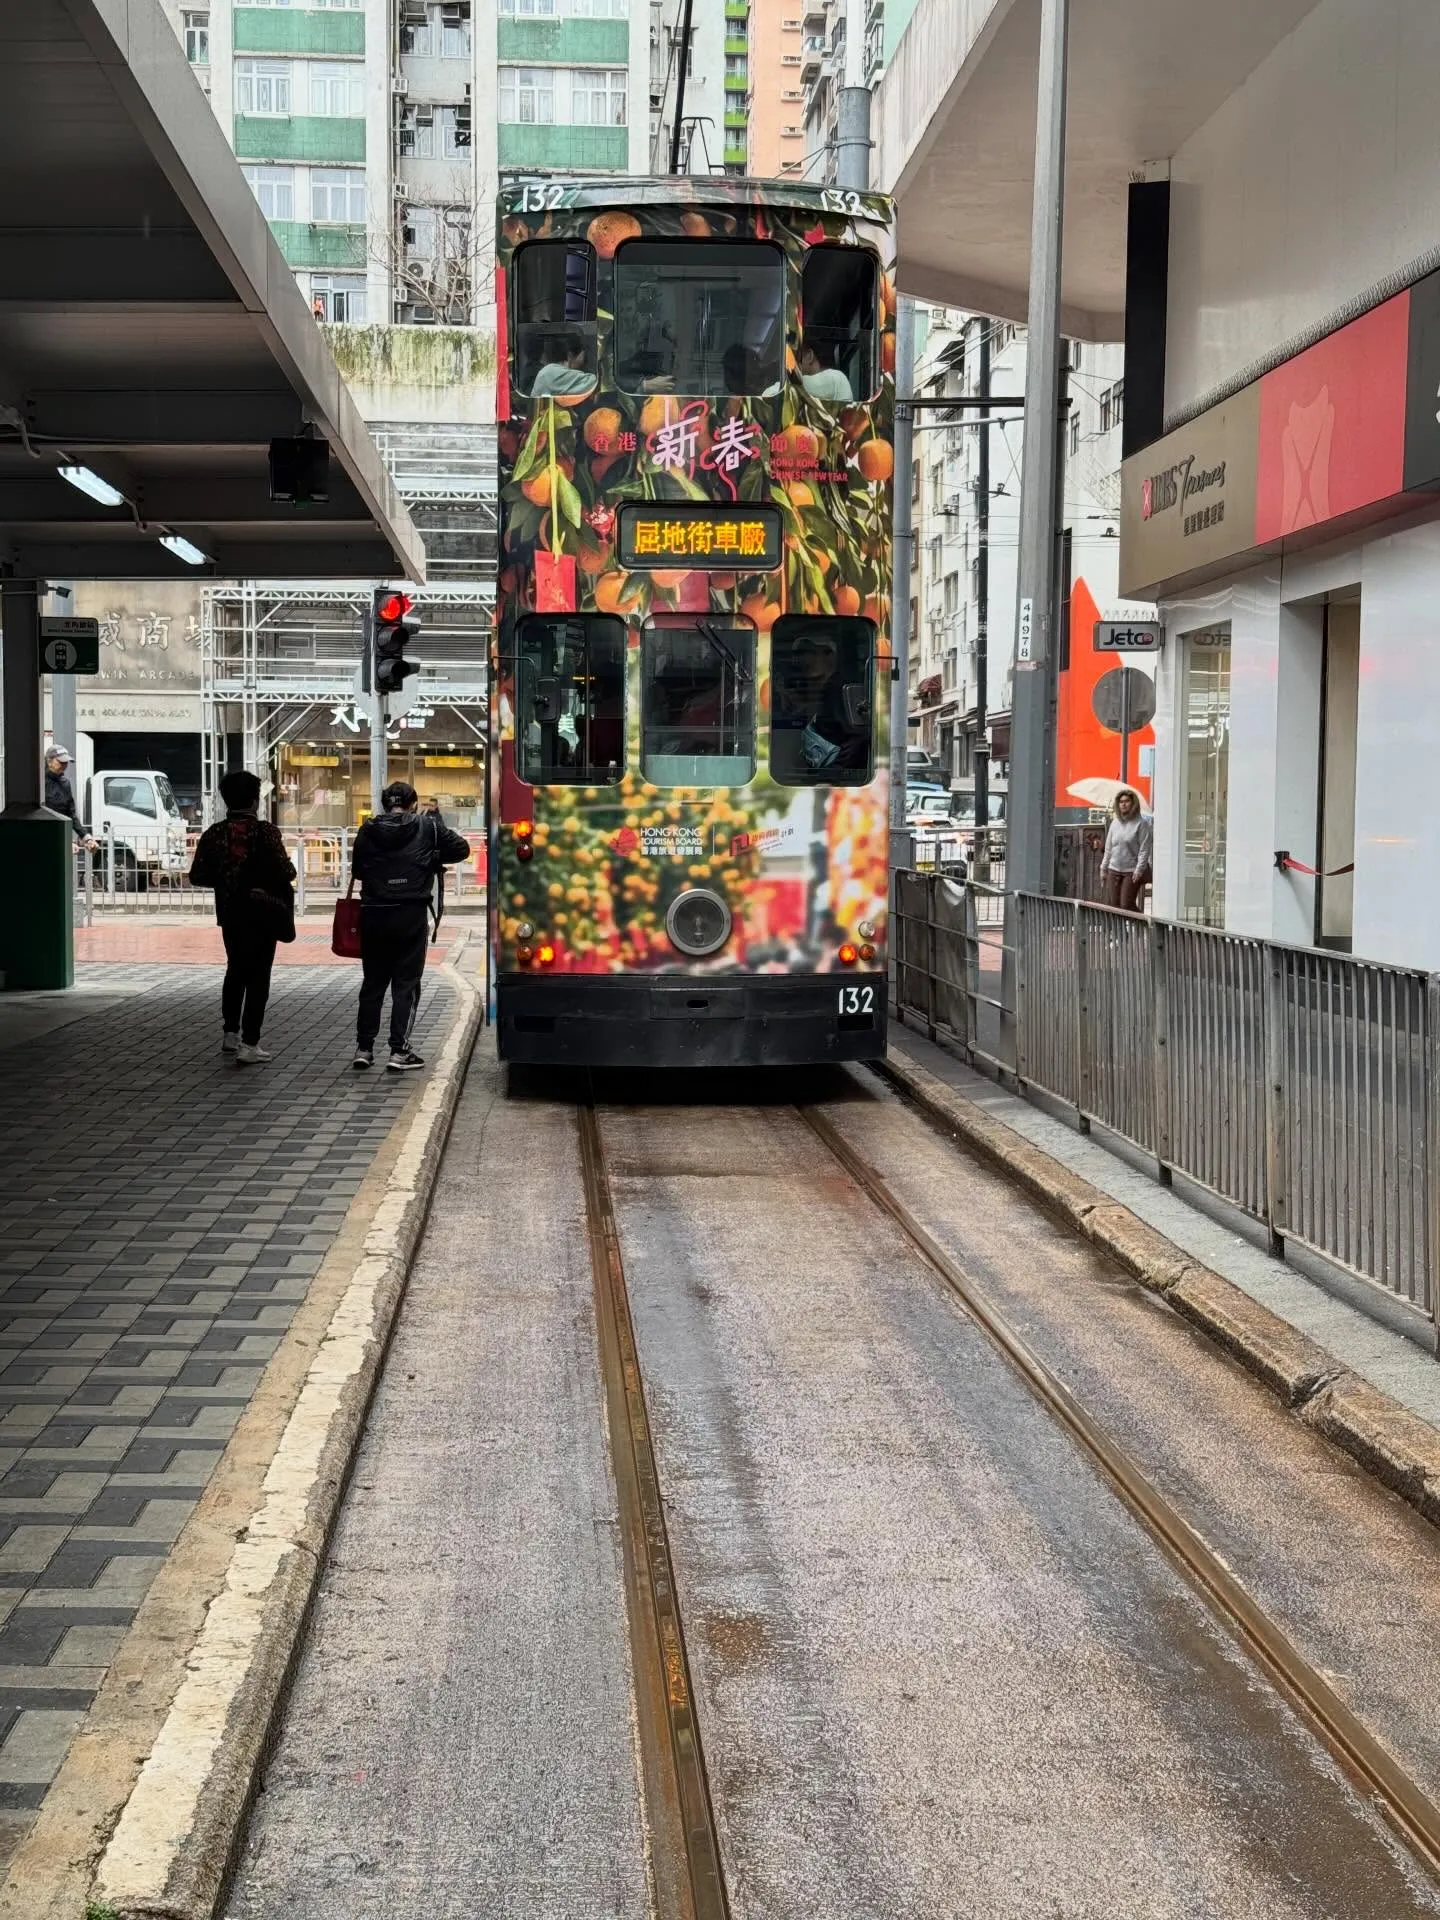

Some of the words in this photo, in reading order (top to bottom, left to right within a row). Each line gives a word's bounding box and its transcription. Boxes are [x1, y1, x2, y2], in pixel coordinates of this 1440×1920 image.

[522, 184, 564, 213] 132
[821, 189, 863, 216] 132
[591, 431, 637, 452] 香港
[1021, 604, 1031, 657] 44978
[640, 827, 671, 837] HONG
[672, 827, 702, 837] KONG
[640, 838, 675, 846] TOURISM
[675, 838, 703, 846] BOARD
[838, 986, 874, 1014] 132
